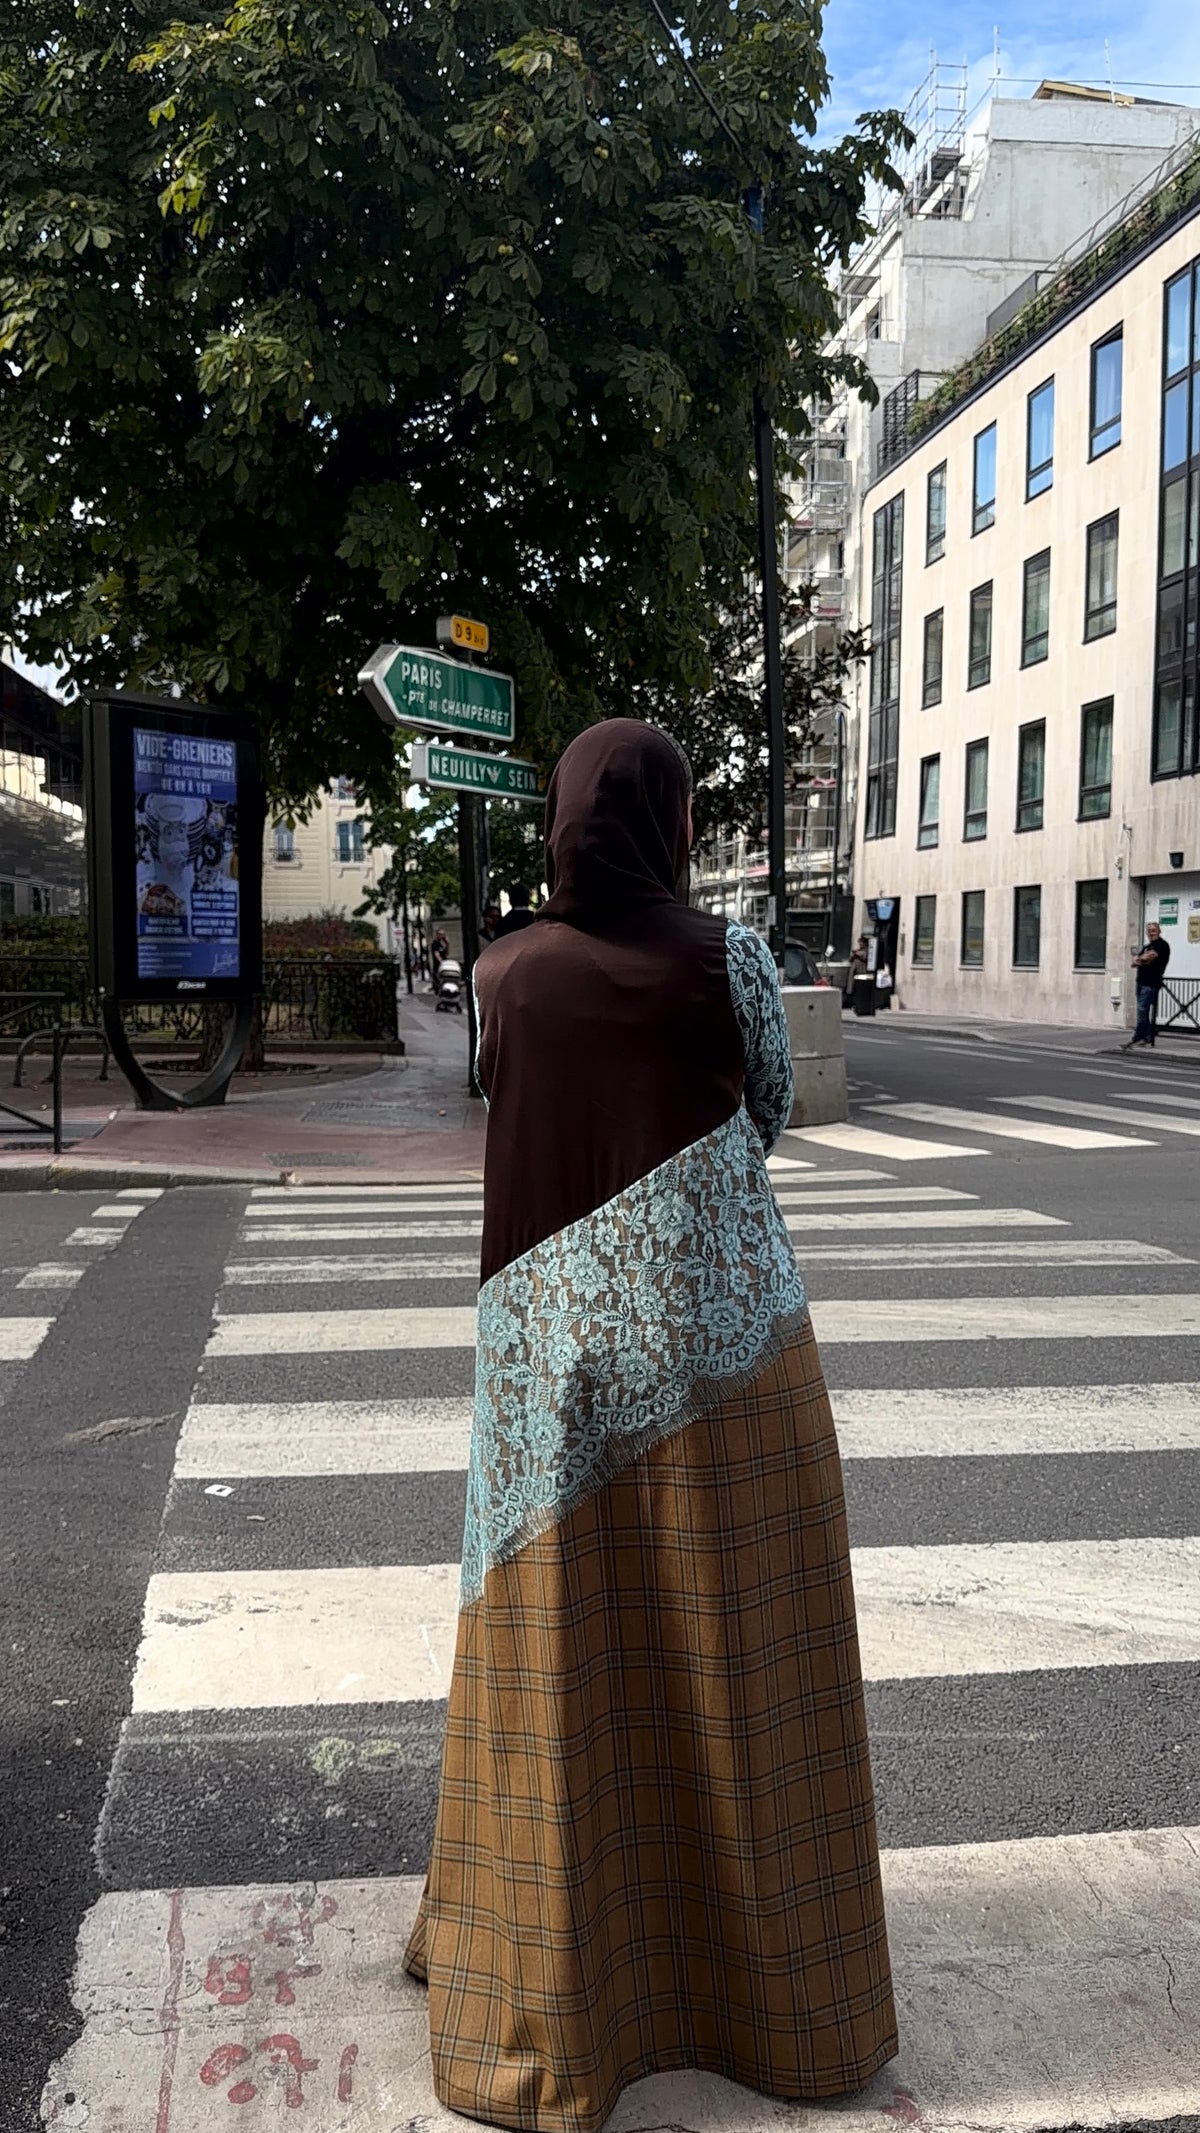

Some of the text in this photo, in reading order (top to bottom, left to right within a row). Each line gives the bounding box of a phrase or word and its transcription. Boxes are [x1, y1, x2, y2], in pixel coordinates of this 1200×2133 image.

[455, 623, 463, 638] D
[465, 625, 473, 641] 9
[401, 662, 442, 689] PARIS
[441, 699, 510, 727] CHAMPERRET
[136, 732, 233, 767] VIDE-GRENIERS
[431, 754, 487, 782] NEUILLY
[508, 768, 537, 792] SEIN
